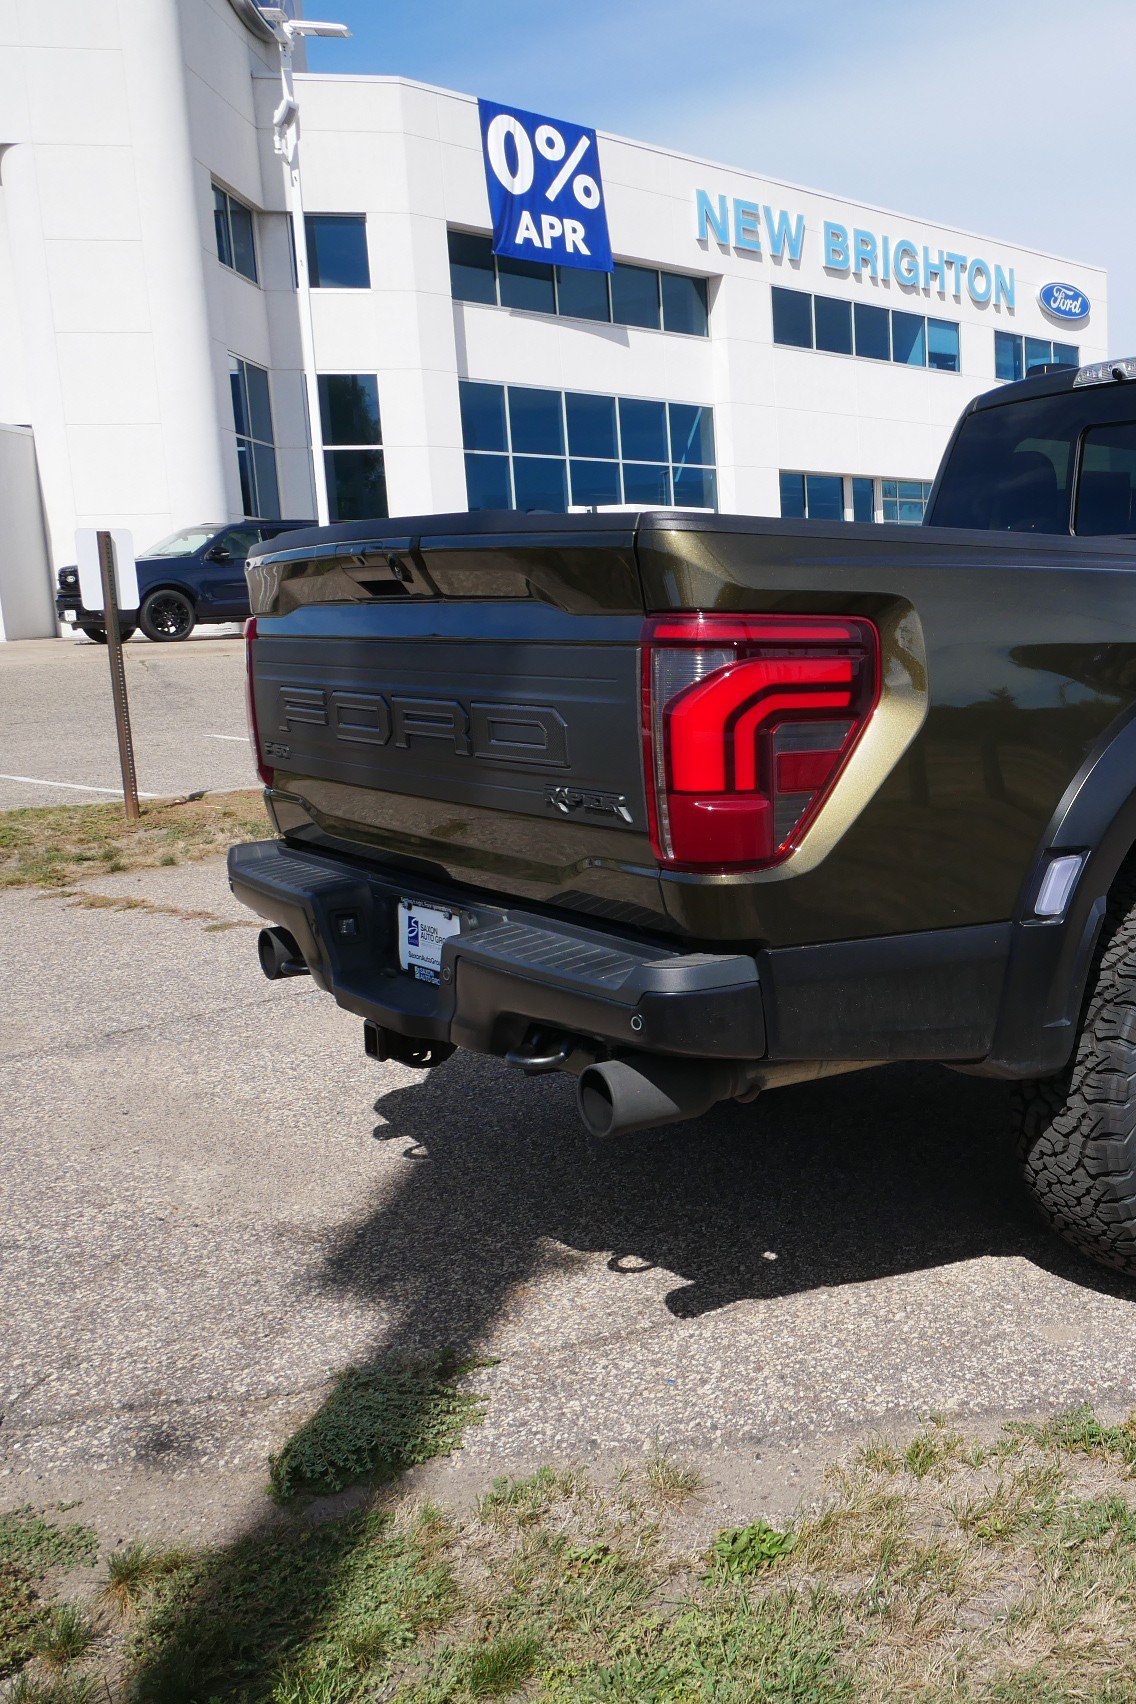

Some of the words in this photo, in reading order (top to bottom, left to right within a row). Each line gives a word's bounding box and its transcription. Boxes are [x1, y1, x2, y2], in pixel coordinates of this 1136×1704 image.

[487, 114, 600, 210] 0%
[515, 210, 592, 256] APR
[696, 188, 805, 261] NEW
[823, 220, 1016, 308] BRIGHTON
[1050, 285, 1083, 314] Ford
[278, 685, 571, 769] FORD
[420, 923, 439, 935] SAXON
[420, 931, 435, 943] AUTO
